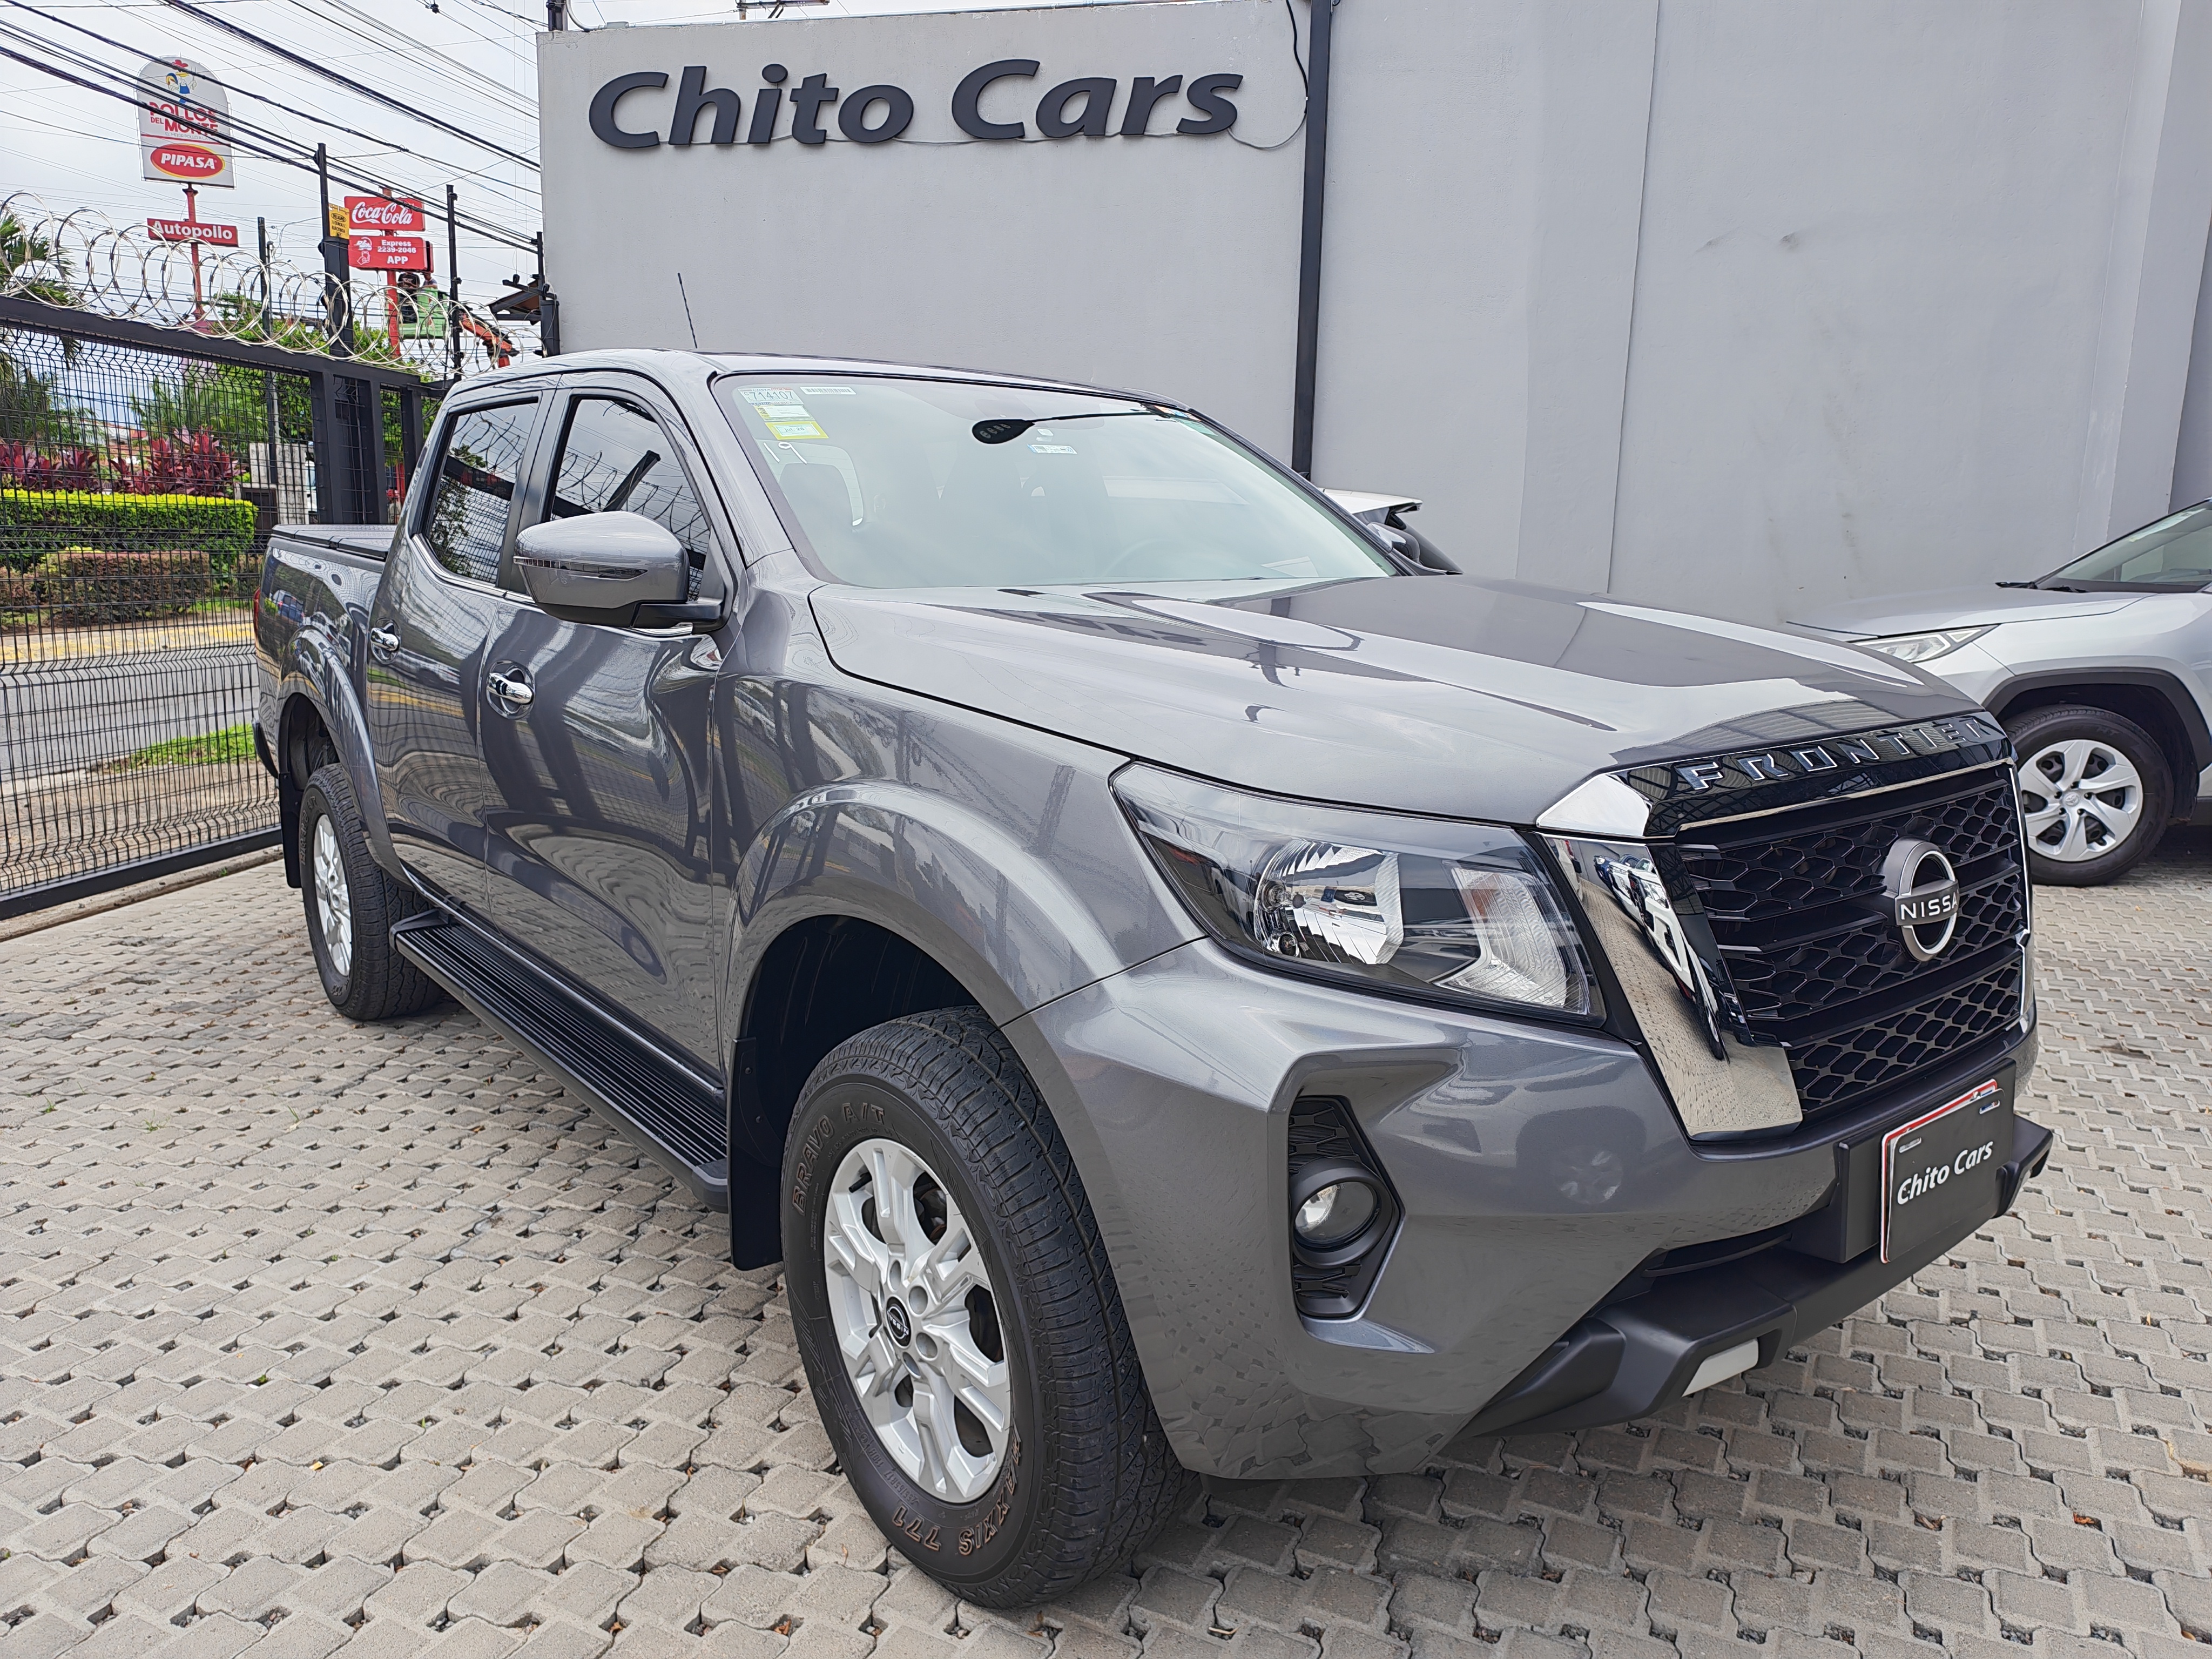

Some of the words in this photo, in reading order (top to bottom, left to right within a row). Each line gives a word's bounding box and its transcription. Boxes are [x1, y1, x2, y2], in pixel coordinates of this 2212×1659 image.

[588, 63, 914, 150] Chito
[952, 59, 1244, 140] Cars
[161, 153, 215, 170] PIPASA
[352, 201, 414, 225] Coca-Cola
[152, 221, 233, 240] Autopollo
[387, 255, 408, 265] APP
[749, 391, 794, 400] 714107
[1675, 717, 1992, 790] FRONTIER
[1900, 889, 1959, 920] NISSA
[792, 1115, 835, 1216] BRAVO
[842, 1102, 885, 1125] A/T
[1897, 1162, 1950, 1205] Chito
[1954, 1141, 1994, 1176] Cars
[892, 1505, 941, 1552] 771
